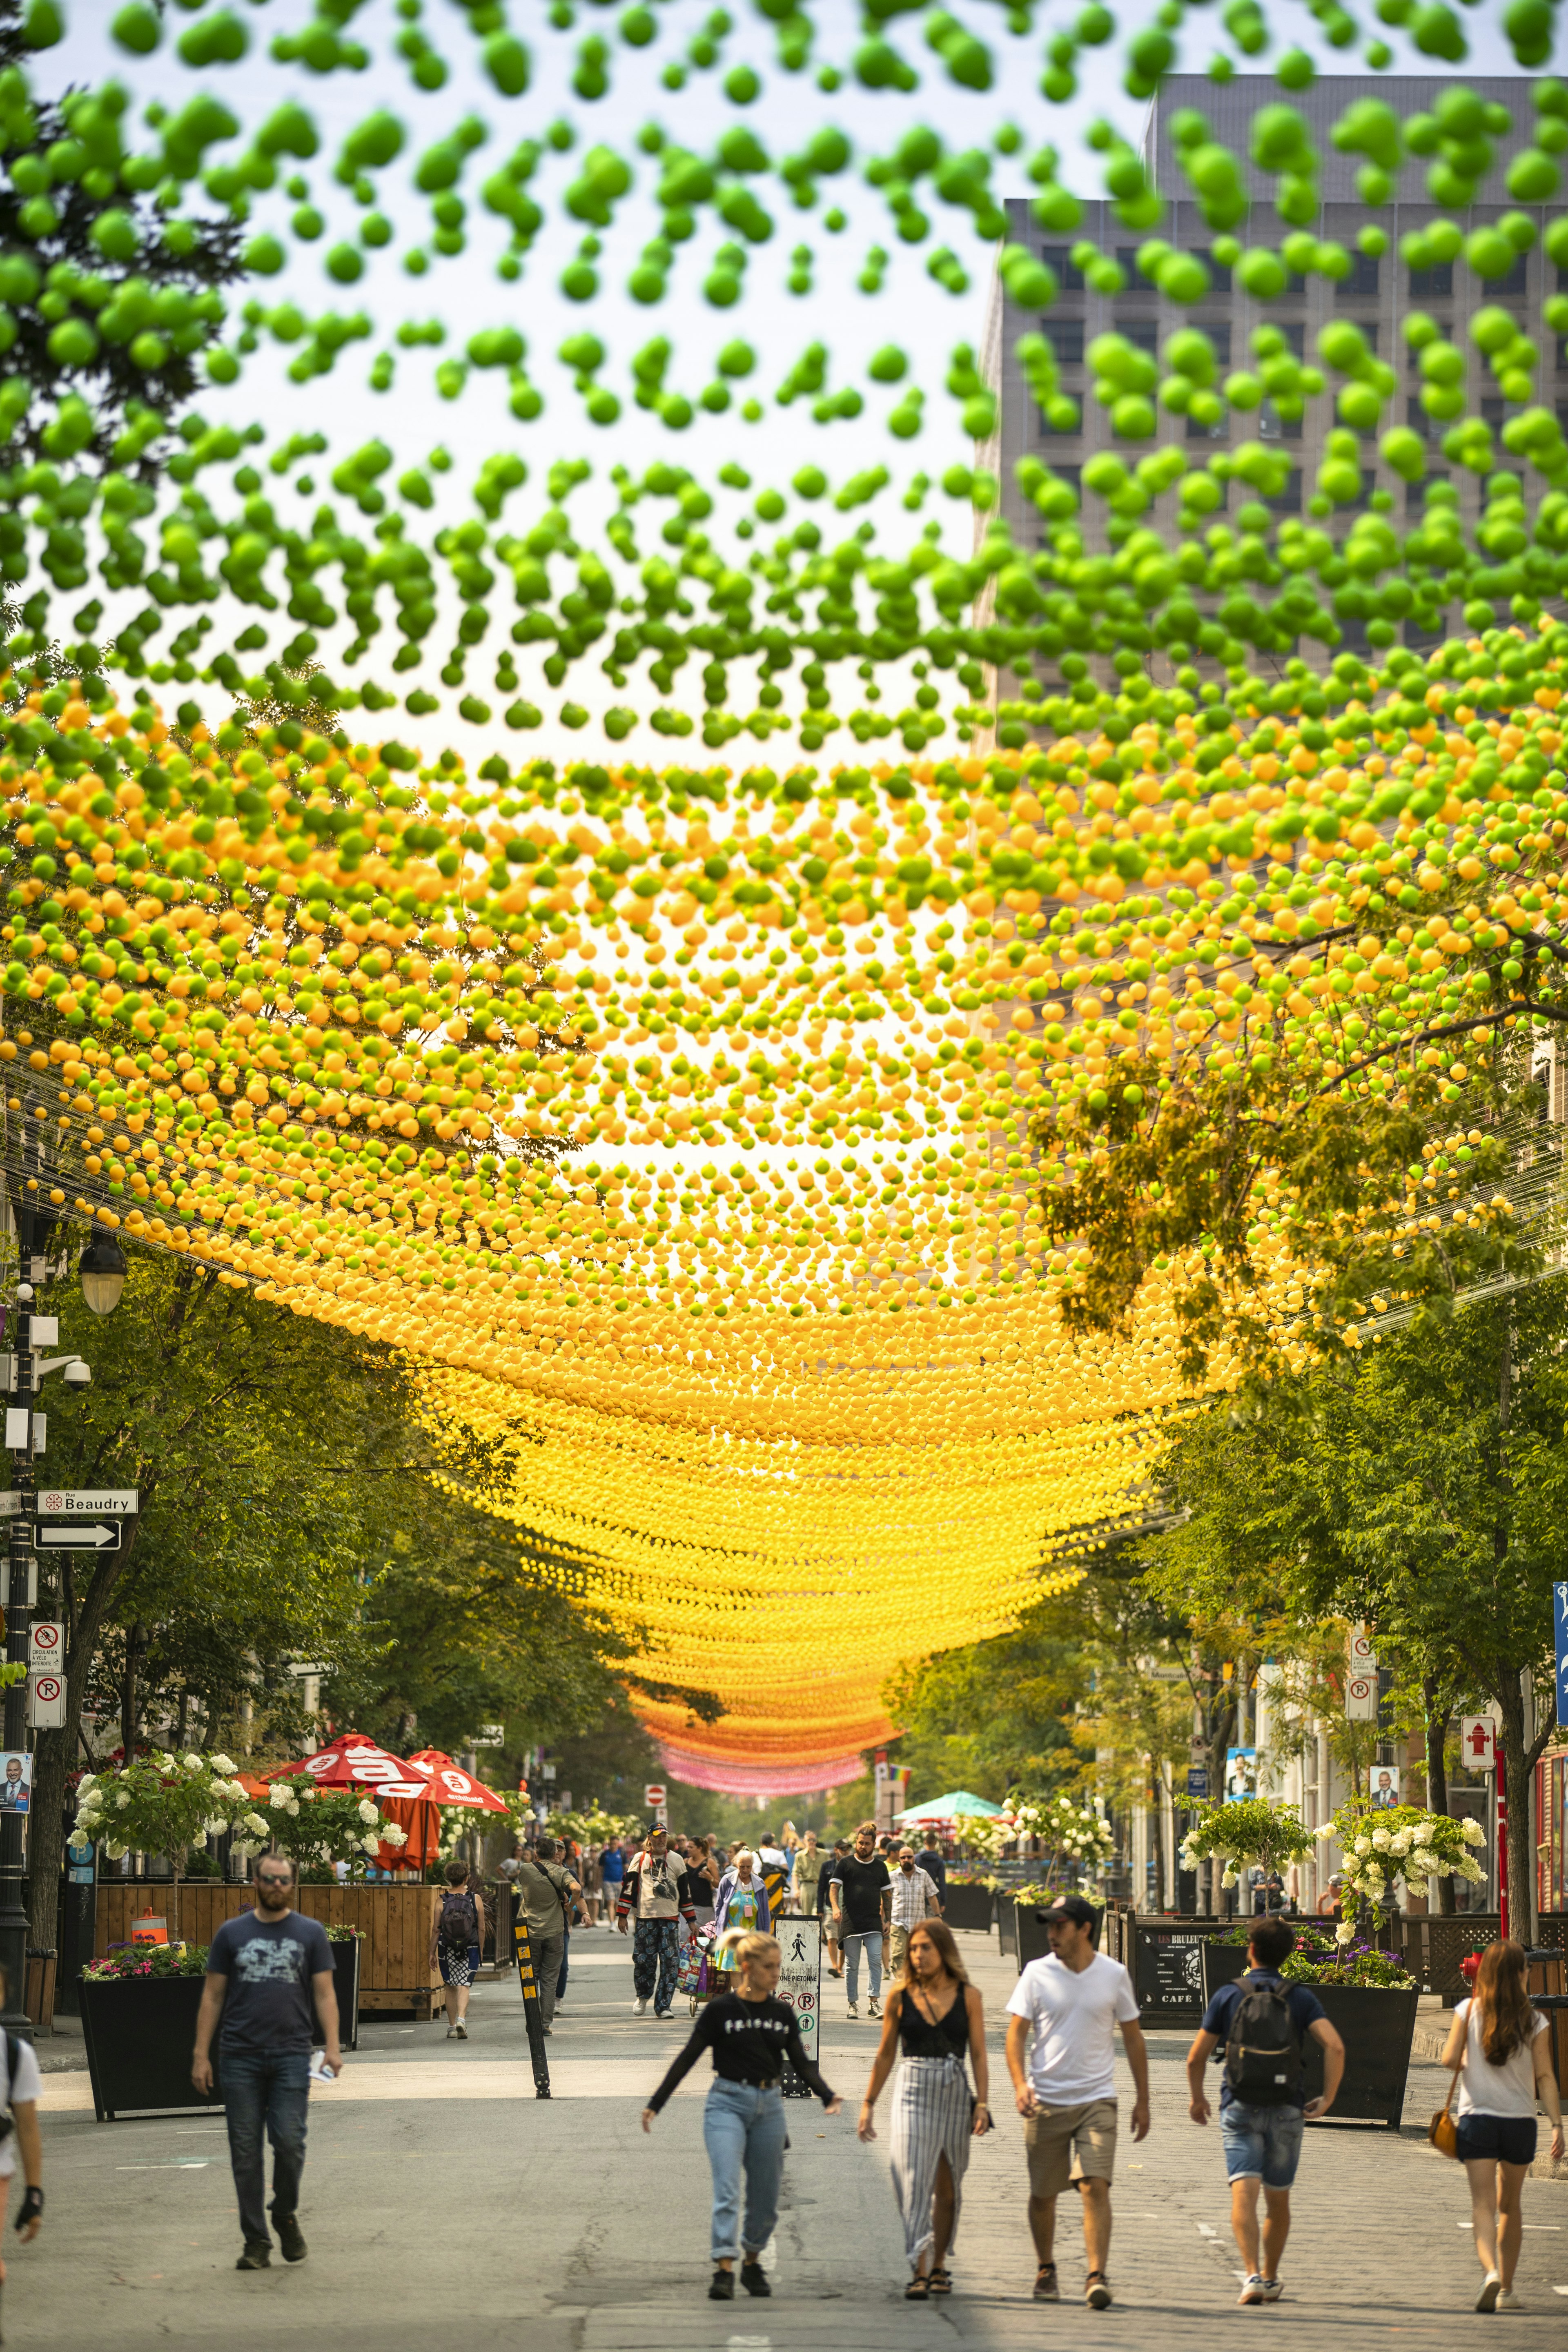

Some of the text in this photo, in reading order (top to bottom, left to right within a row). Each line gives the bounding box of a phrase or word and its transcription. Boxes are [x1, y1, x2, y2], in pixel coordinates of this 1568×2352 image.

[66, 1498, 128, 1511] Beaudry
[447, 1794, 484, 1804] archibald
[1158, 1935, 1170, 1944] LES
